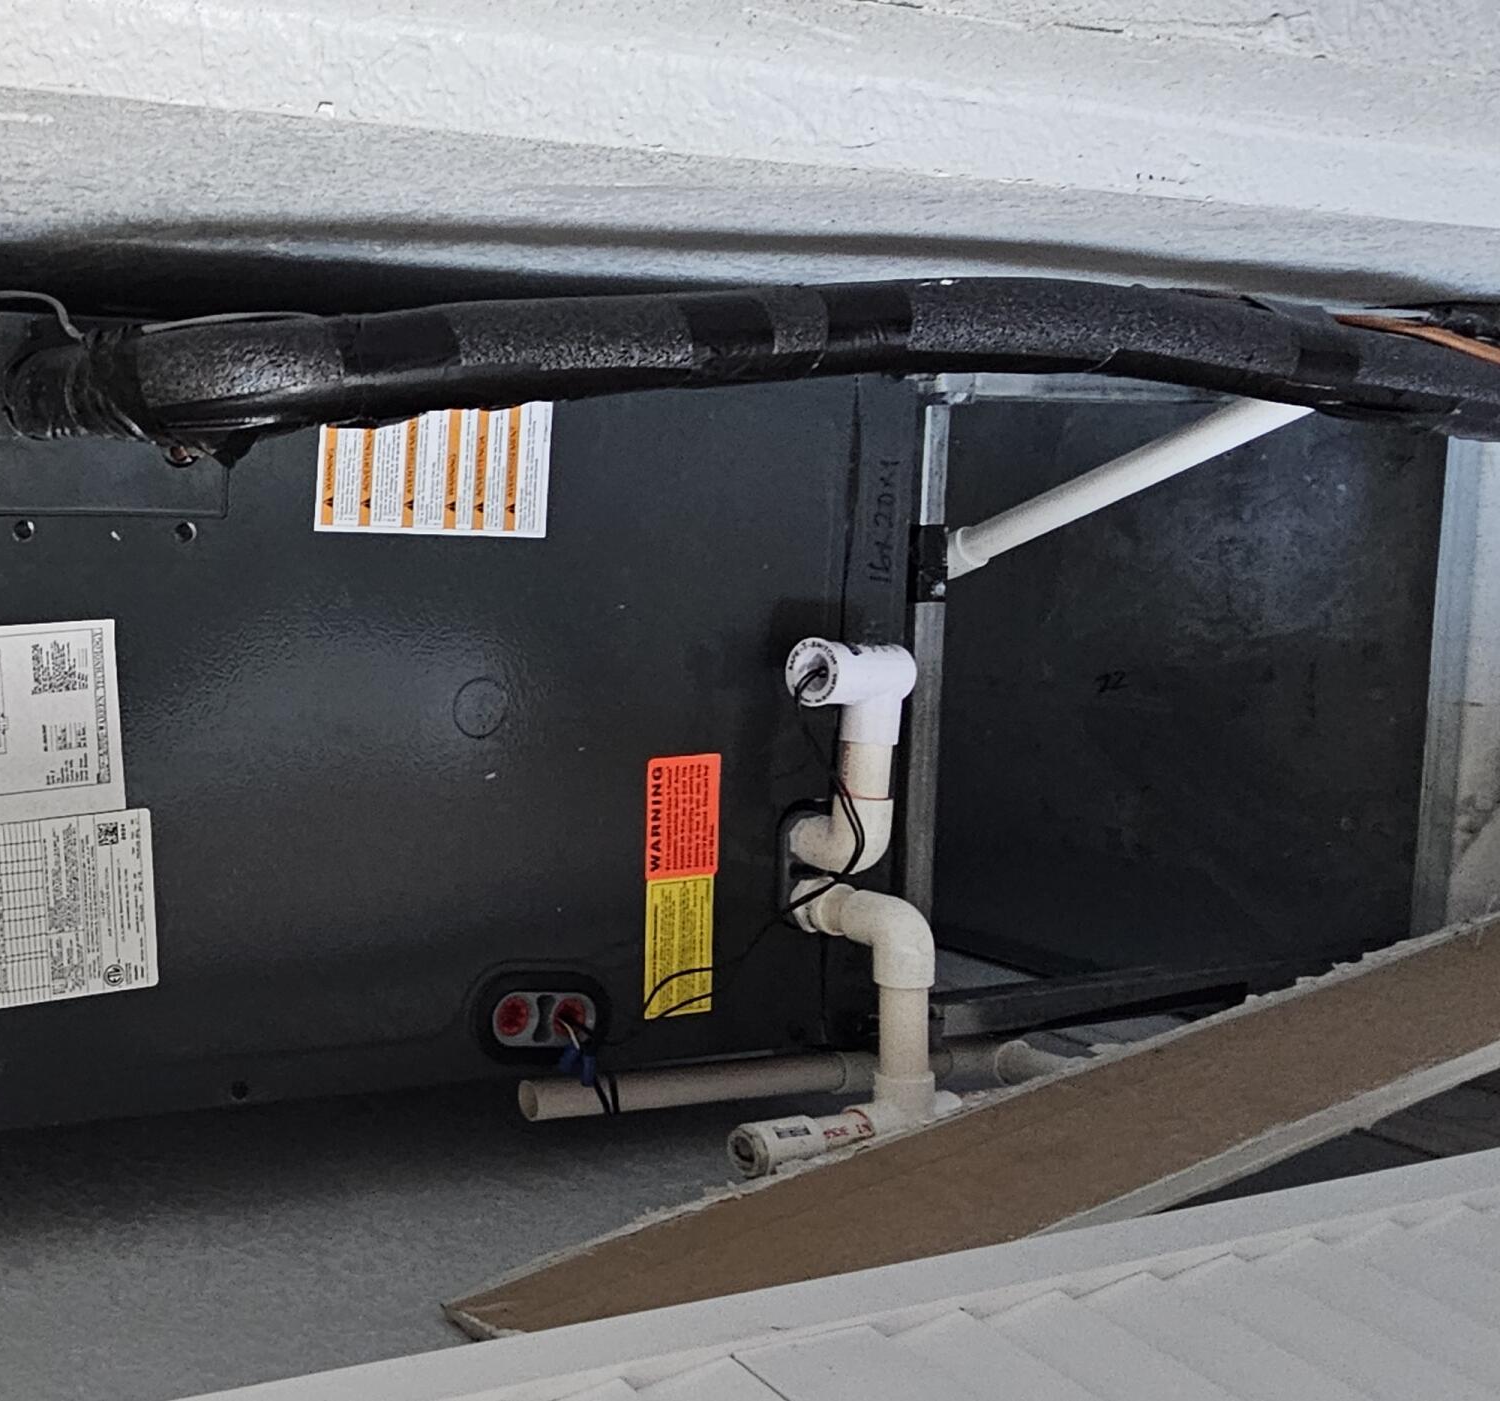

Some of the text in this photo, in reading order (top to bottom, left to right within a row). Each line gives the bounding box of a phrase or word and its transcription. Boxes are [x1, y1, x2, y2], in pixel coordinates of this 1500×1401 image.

[326, 448, 334, 491] WARNING
[448, 453, 456, 496] WARNING
[475, 435, 484, 496] ADVERTENCIA
[650, 767, 662, 872] WARNING
